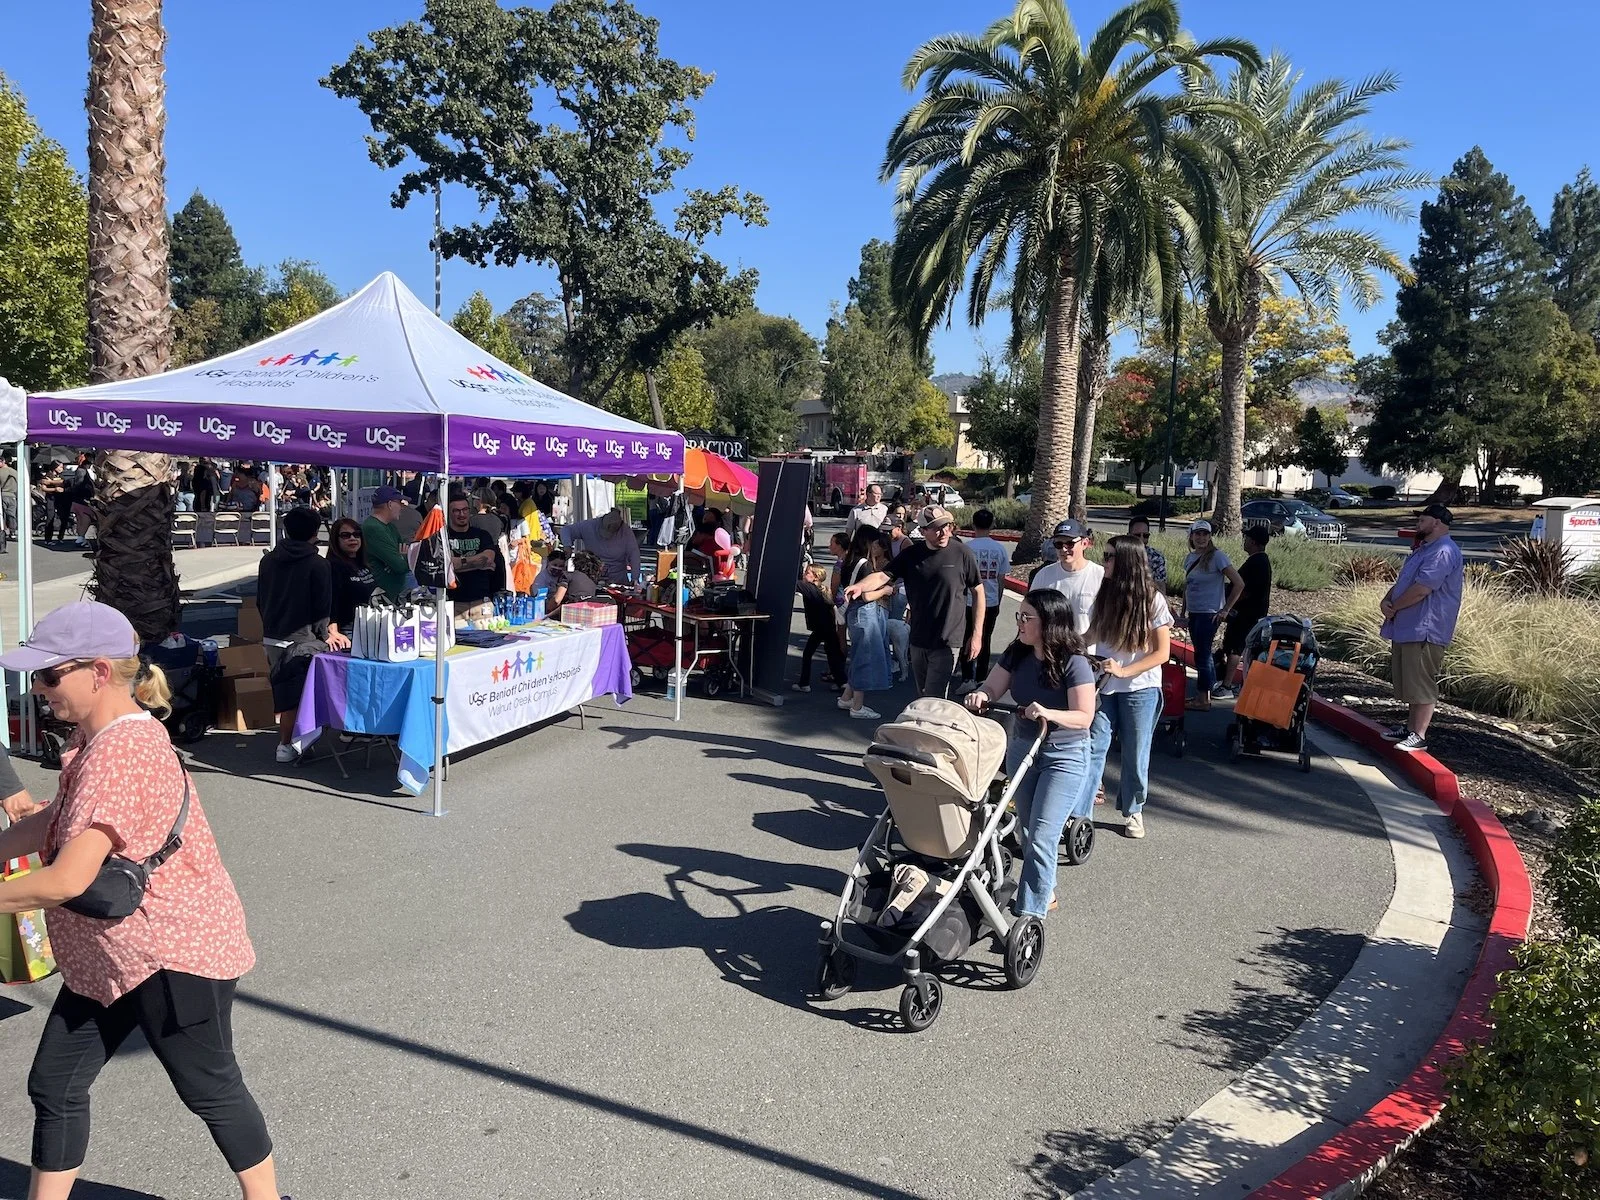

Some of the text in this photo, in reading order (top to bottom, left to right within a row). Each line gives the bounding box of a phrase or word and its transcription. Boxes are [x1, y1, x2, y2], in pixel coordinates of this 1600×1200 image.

[216, 379, 295, 388] Hospitals
[233, 368, 297, 378] Benioff
[295, 369, 380, 383] Children's
[48, 409, 406, 452] UCSF UCSF UCSF UCSF UCSF UCSF UCSF
[472, 432, 672, 460] UCSF UCSF UCSF UCSF UCSF UCSF UCSF
[685, 439, 743, 458] RACTOR
[468, 691, 487, 706] UCSF
[489, 684, 517, 703] Benioff
[513, 694, 531, 709] Creek
